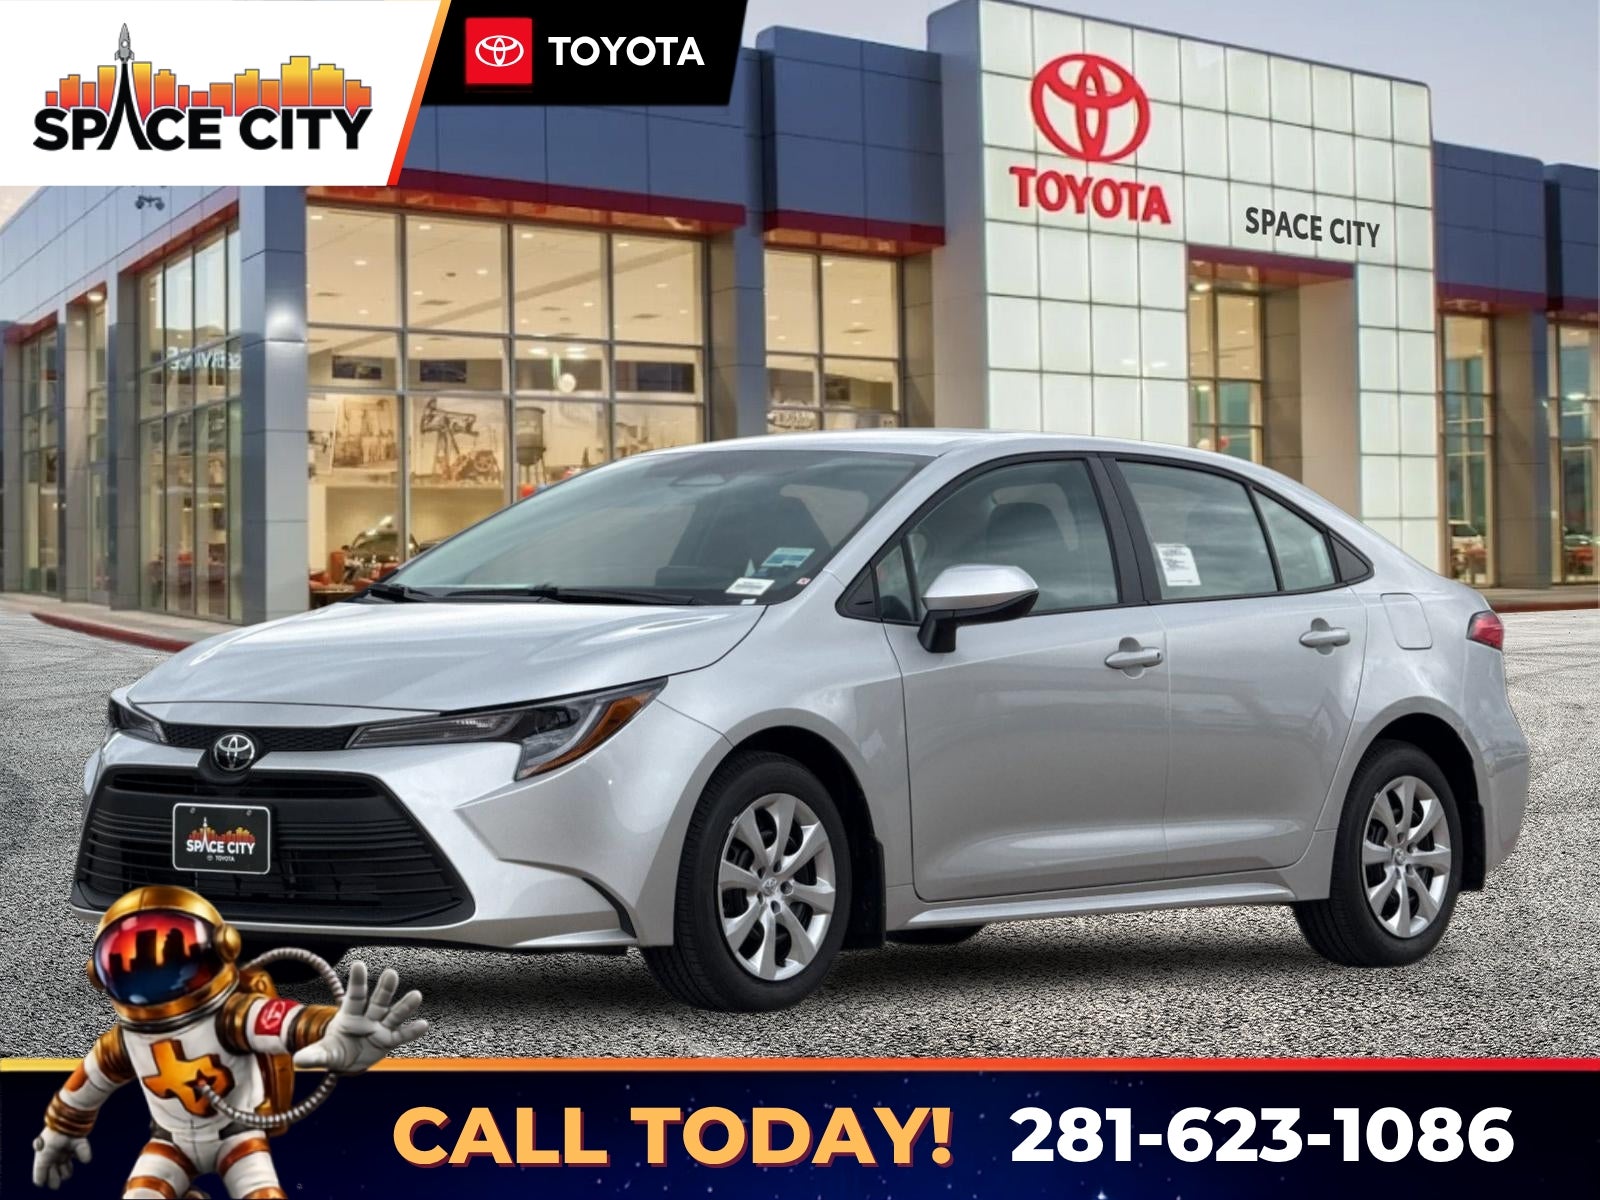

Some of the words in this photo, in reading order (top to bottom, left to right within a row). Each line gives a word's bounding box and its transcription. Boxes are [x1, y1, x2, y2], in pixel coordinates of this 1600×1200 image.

[1008, 166, 1171, 225] TOYOTA
[1245, 206, 1323, 242] SPACE
[1329, 217, 1380, 248] CITY
[186, 838, 225, 853] SPACE
[227, 841, 256, 855] CITY
